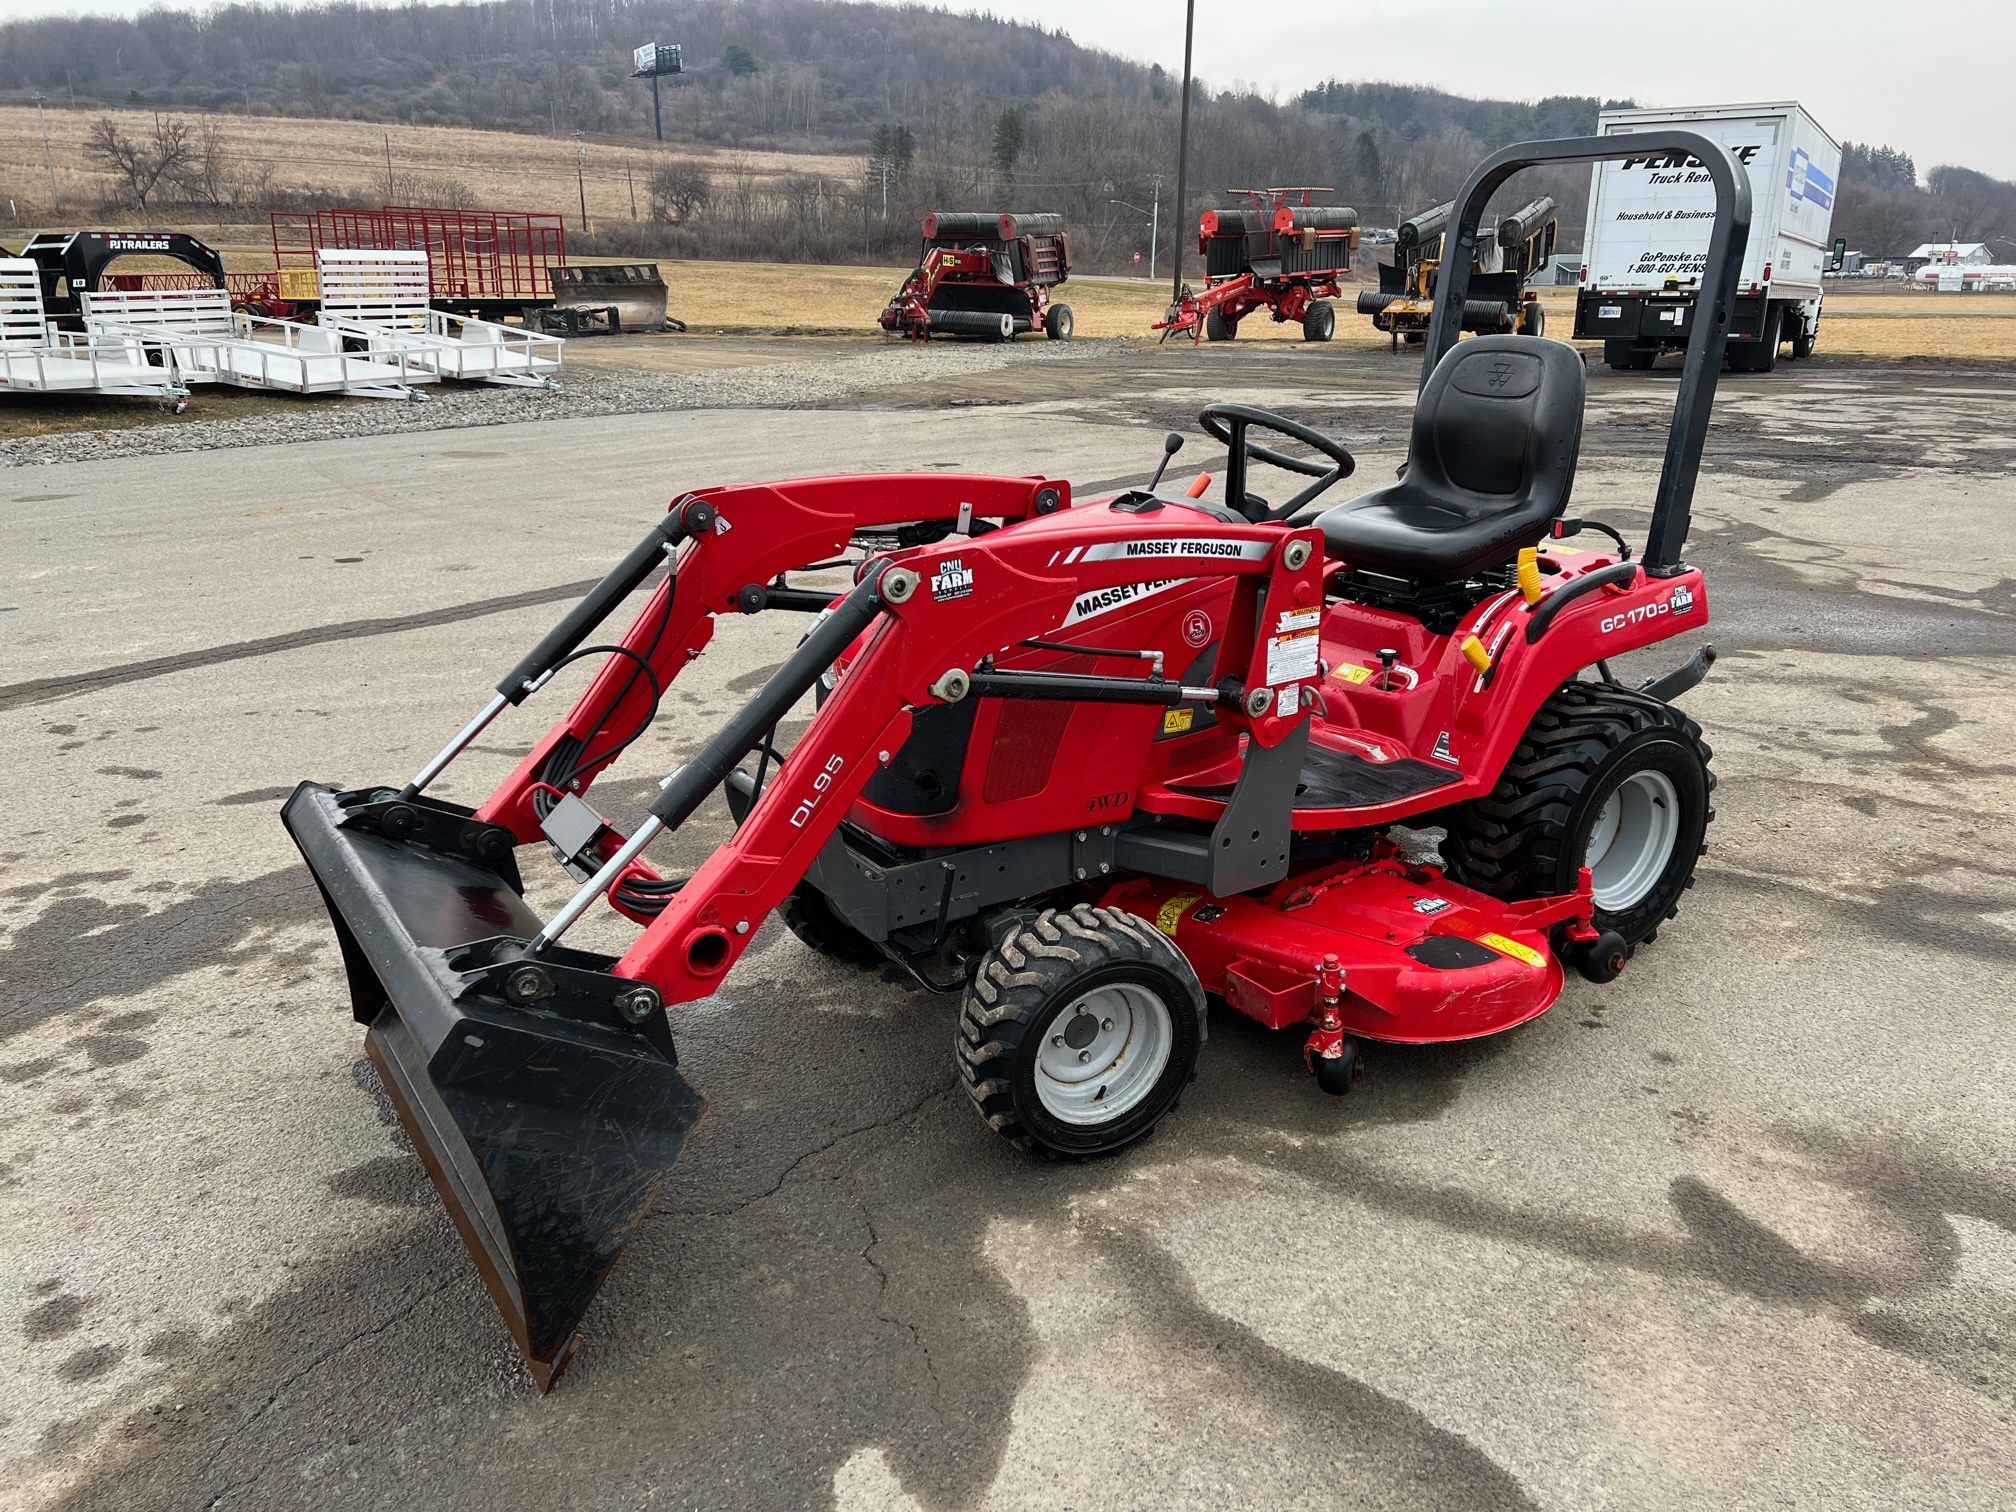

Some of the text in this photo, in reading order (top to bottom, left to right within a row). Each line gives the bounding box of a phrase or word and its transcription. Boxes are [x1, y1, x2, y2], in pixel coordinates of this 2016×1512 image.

[1648, 172, 1683, 184] Truck
[1616, 209, 1716, 220] Household & Business
[110, 240, 169, 250] PJ TRAILERS
[1640, 252, 1707, 262] GoPenske.co
[1127, 542, 1242, 556] MASSEY FERGUSON
[930, 568, 974, 592] FARM
[1076, 583, 1139, 617] MASSEY
[790, 754, 844, 828] DL95
[1084, 792, 1129, 812] 4WD
